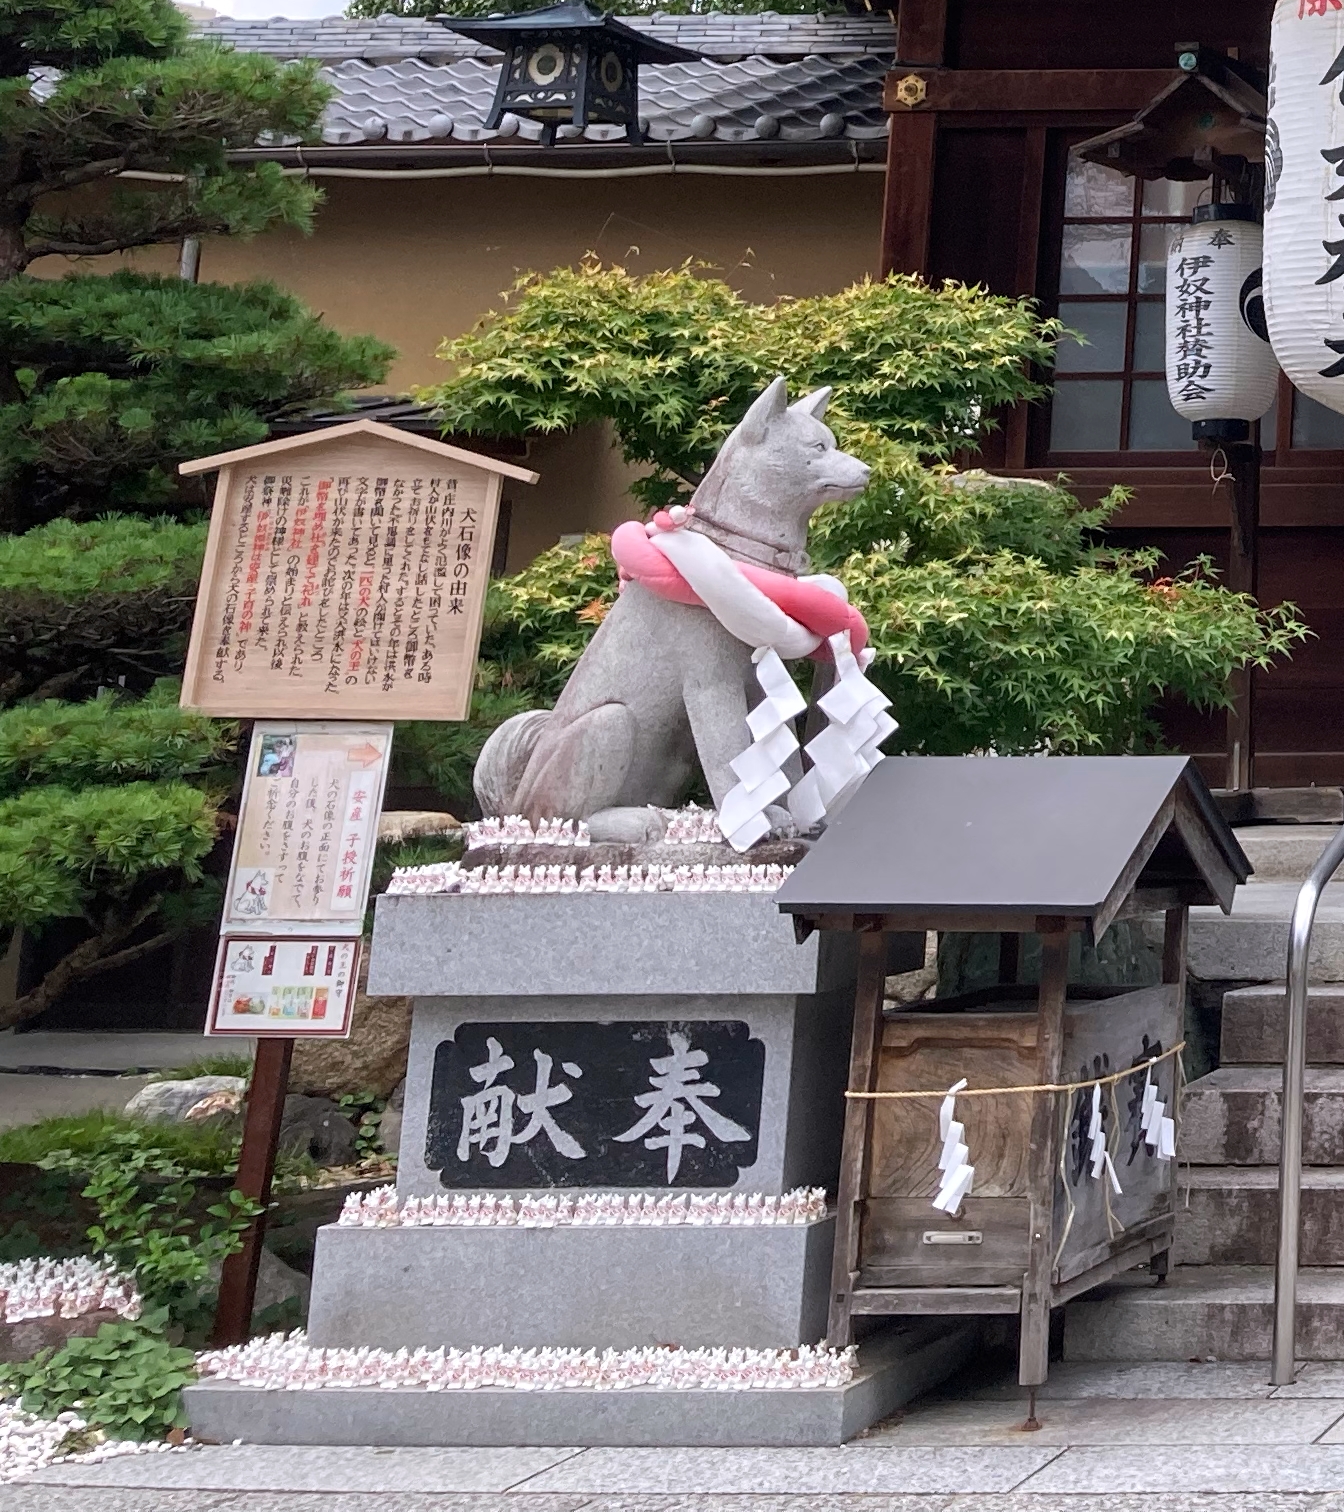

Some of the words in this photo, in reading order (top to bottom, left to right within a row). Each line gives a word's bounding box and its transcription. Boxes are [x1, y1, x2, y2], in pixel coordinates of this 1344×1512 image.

[1174, 255, 1216, 402] 伊奴神社賛助会
[446, 509, 477, 614] 犬石像の由来
[348, 790, 367, 822] 安産
[336, 833, 361, 899] 子授祈願
